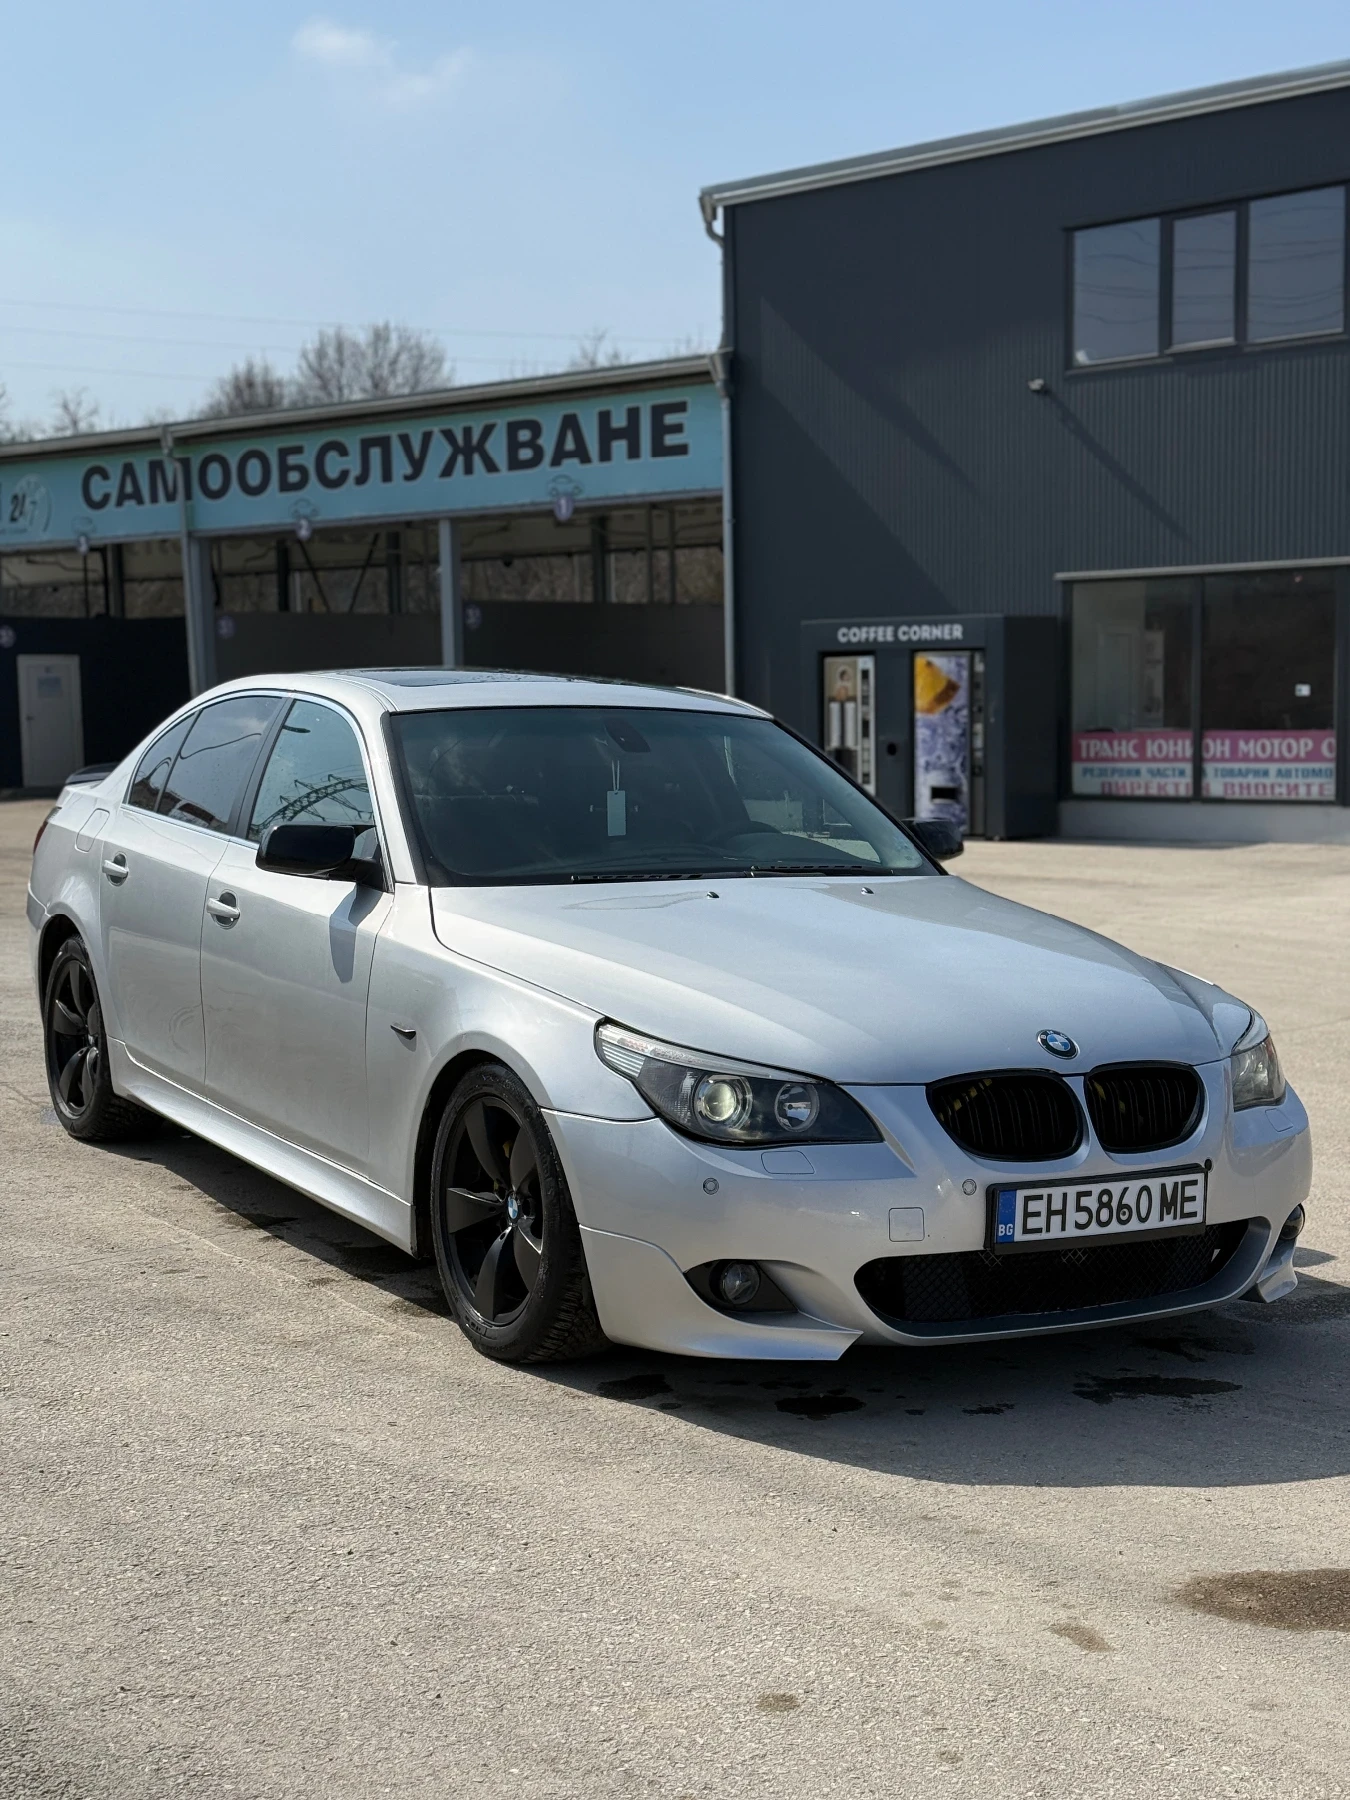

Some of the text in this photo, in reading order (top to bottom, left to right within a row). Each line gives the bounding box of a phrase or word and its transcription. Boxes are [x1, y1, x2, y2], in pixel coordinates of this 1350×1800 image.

[82, 400, 689, 511] САМООБСЛУЖВАНЕ
[837, 624, 963, 643] COFFEE CORNER
[1079, 739, 1139, 759] ТРАНС
[1238, 738, 1313, 759] МОТОР
[998, 1223, 1013, 1236] BG
